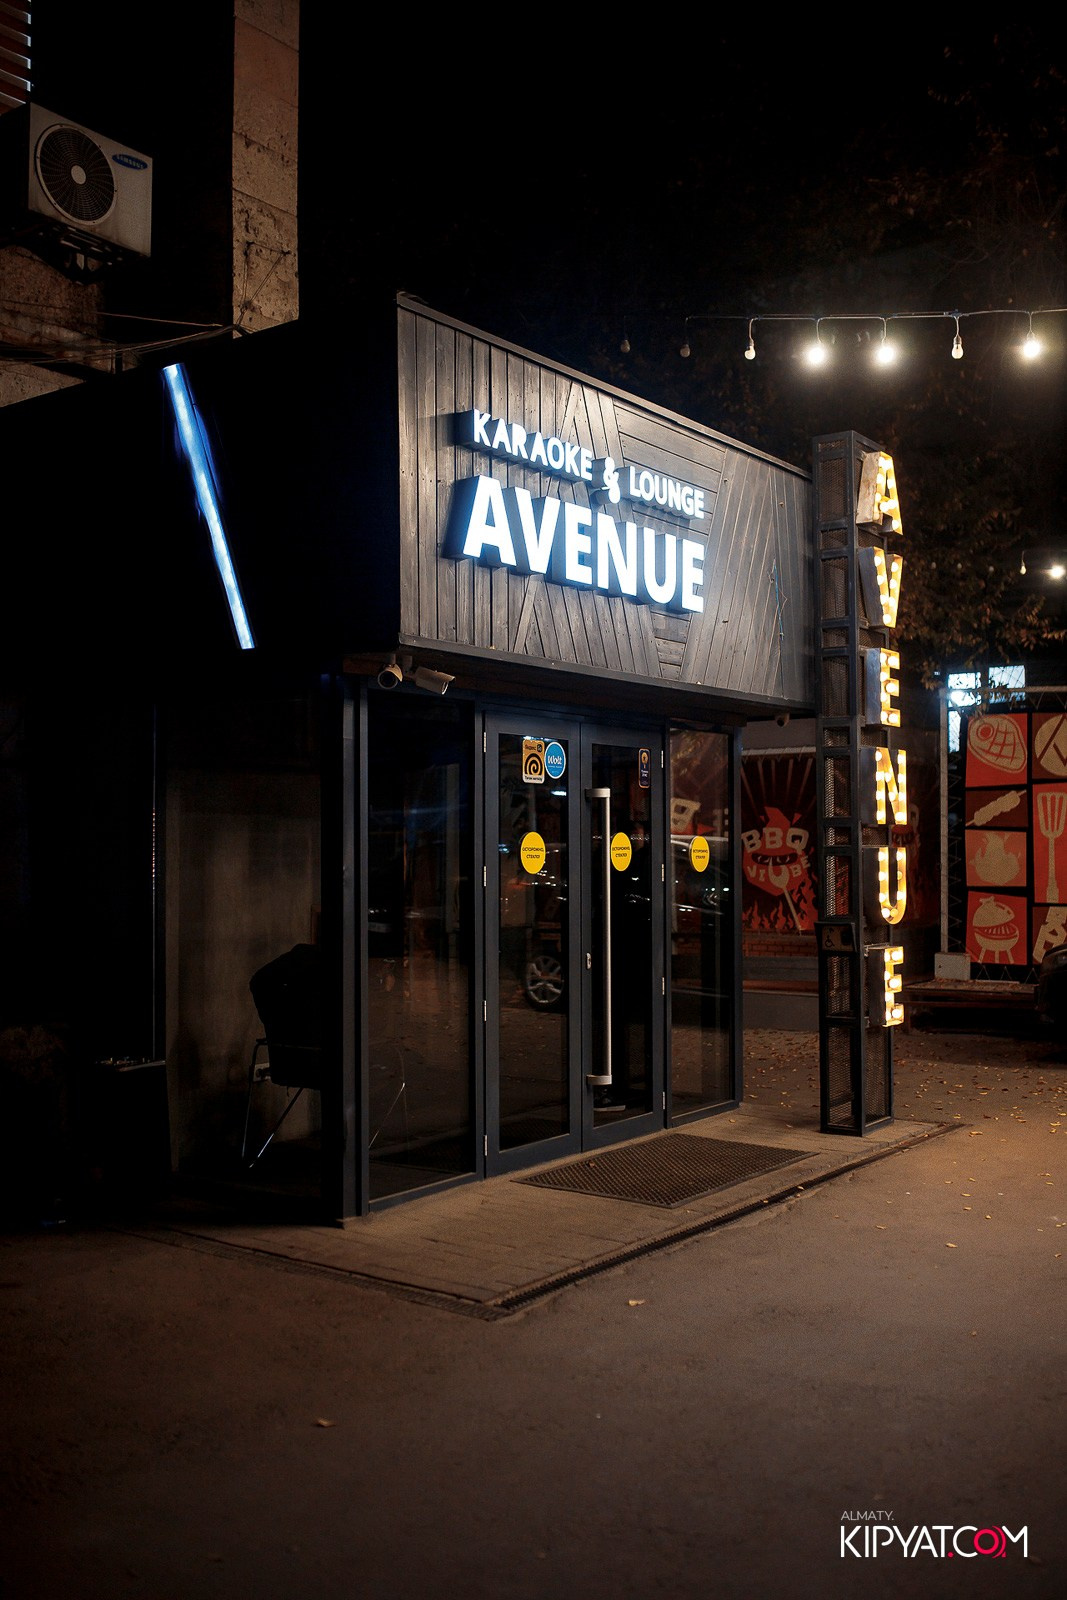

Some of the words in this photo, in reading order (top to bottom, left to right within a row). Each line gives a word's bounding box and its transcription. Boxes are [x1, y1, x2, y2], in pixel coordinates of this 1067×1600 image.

[473, 409, 593, 481] KARAOKE
[602, 456, 621, 504] &
[629, 465, 704, 519] LOUNGE
[462, 474, 705, 613] AVENUE
[547, 755, 563, 765] Wolt
[868, 450, 907, 1027] AVENUE
[741, 827, 809, 855] BBQ
